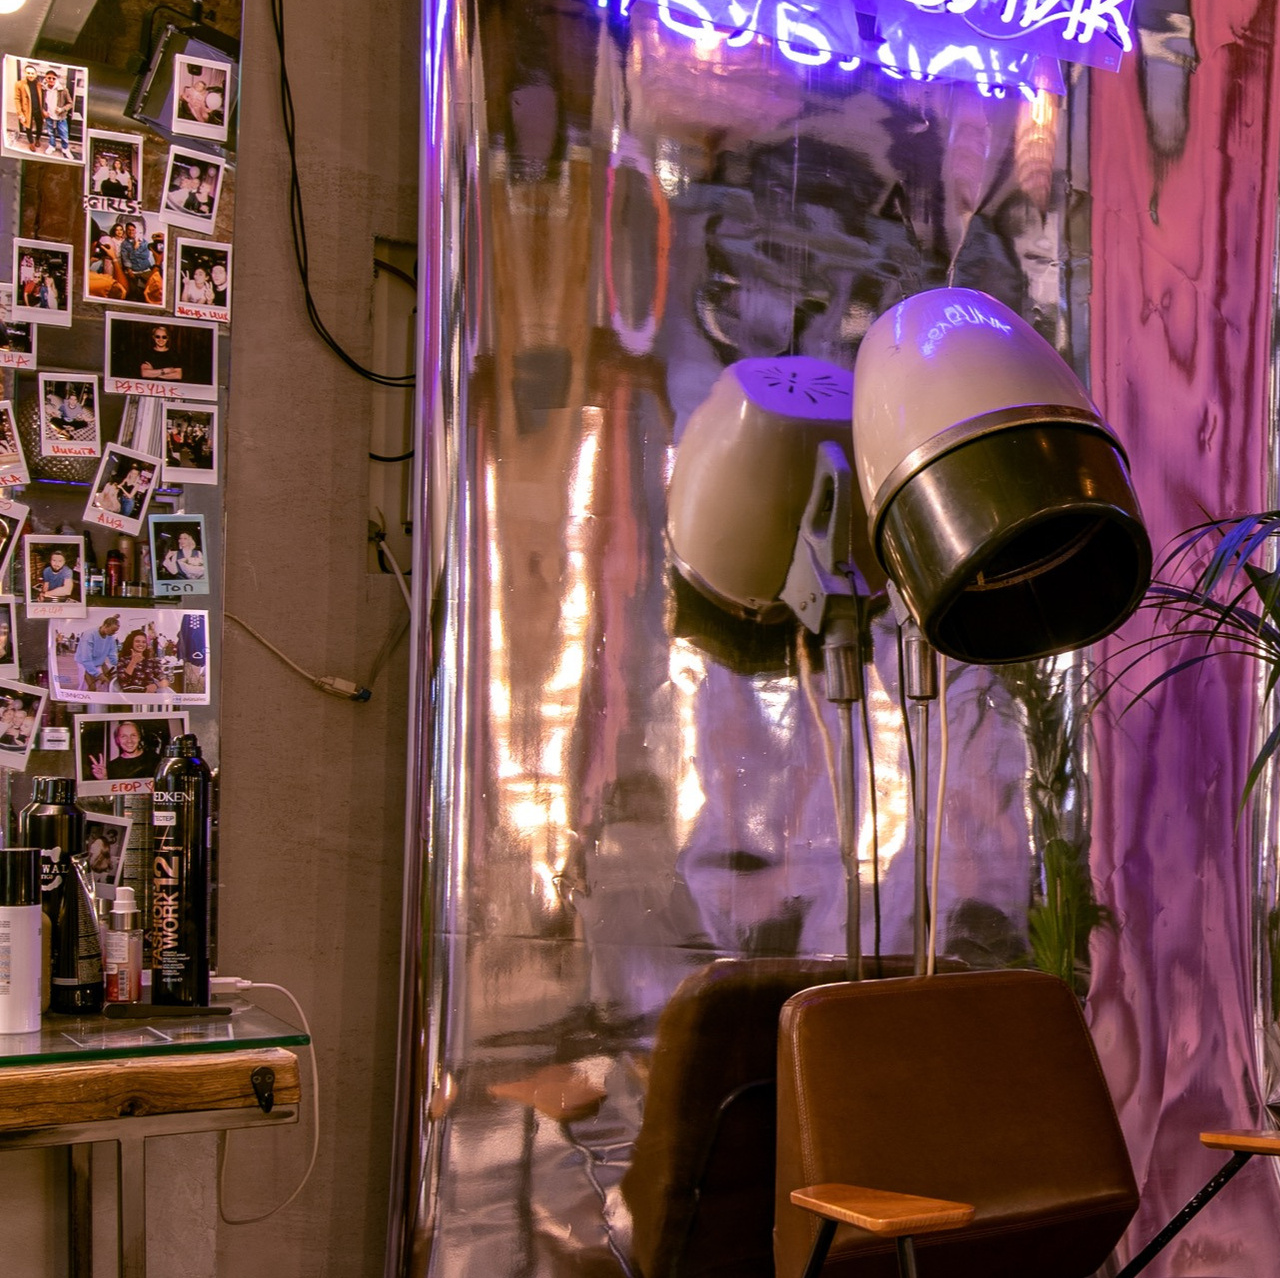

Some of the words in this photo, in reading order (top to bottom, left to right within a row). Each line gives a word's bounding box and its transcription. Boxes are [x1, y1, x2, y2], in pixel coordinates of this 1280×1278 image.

[88, 196, 136, 214] GIRLS
[3, 353, 30, 368] ША
[97, 513, 125, 530] АНЯ
[111, 782, 142, 793] ЕГОР
[154, 856, 179, 885] 12
[162, 891, 179, 950] WORK
